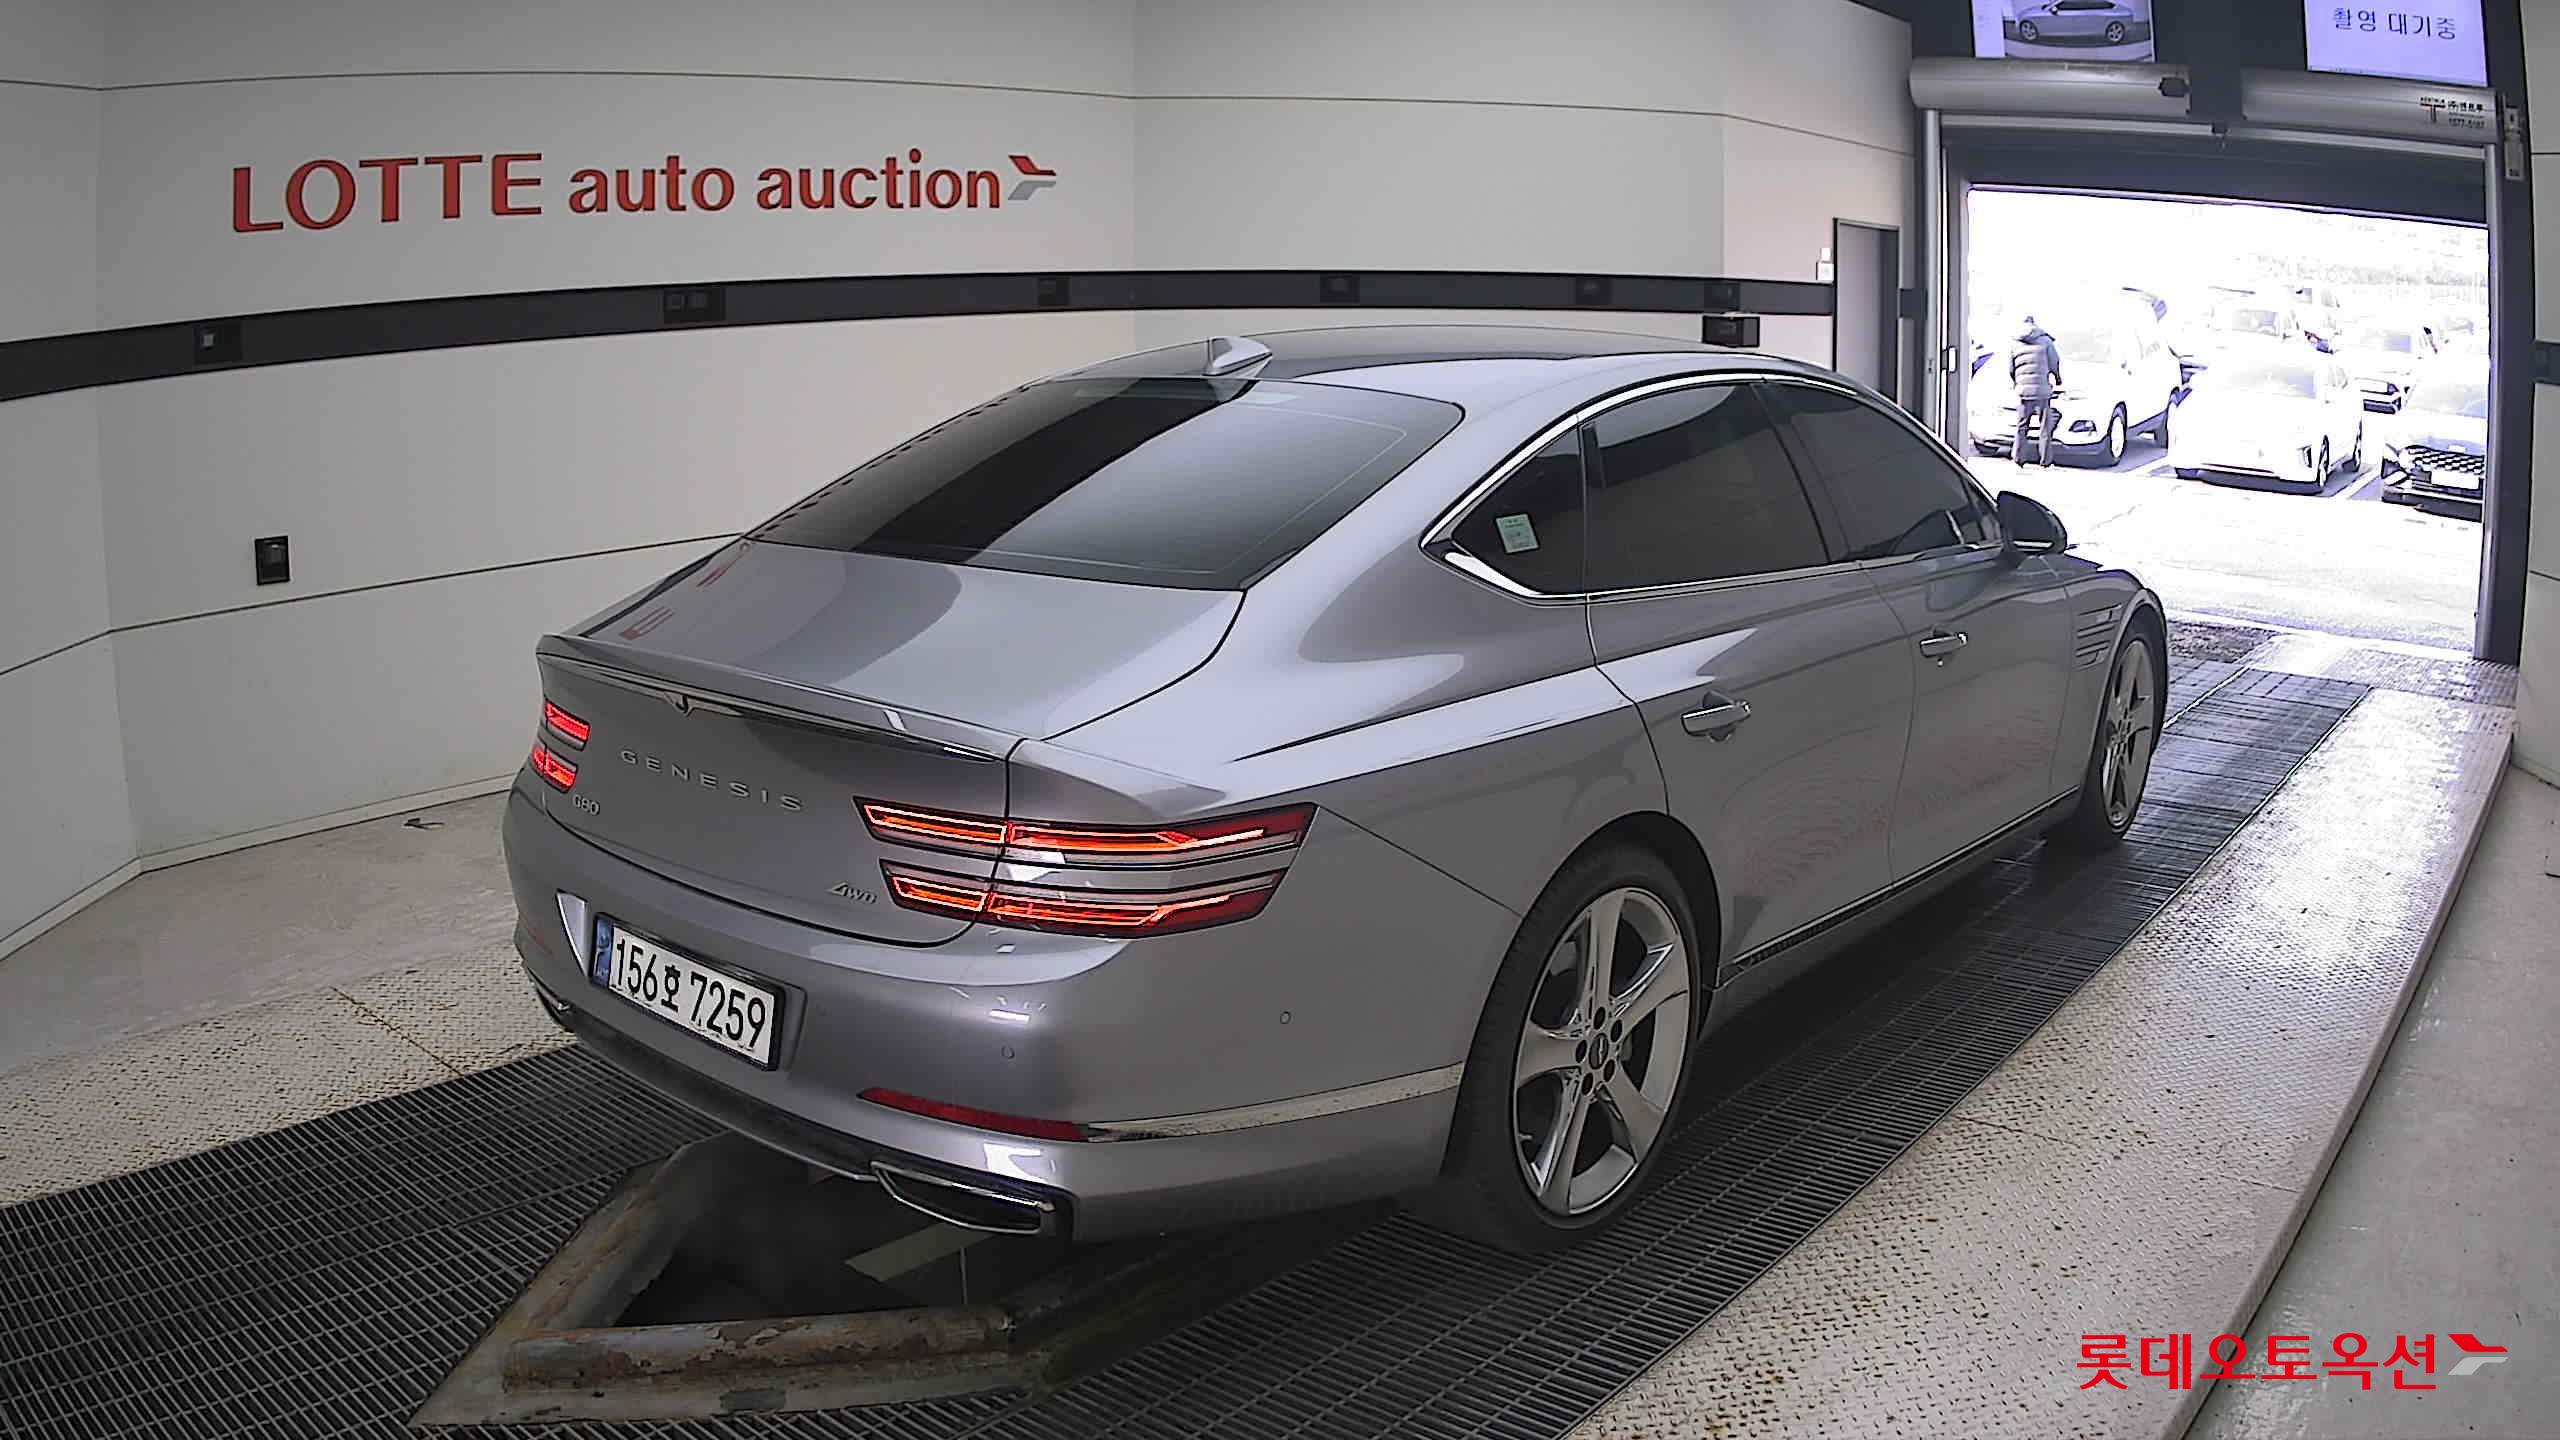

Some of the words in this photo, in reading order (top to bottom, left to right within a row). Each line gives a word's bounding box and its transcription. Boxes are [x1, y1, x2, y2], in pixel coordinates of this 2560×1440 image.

[2334, 7, 2376, 32] 촬영
[2387, 13, 2456, 40] 대기중
[233, 153, 542, 233] LOTTE
[569, 155, 737, 215] auto
[757, 149, 1002, 212] auction
[572, 794, 600, 816] G80
[620, 750, 803, 811] GENESIS
[616, 937, 682, 1013] 156호
[690, 970, 767, 1049] 7259
